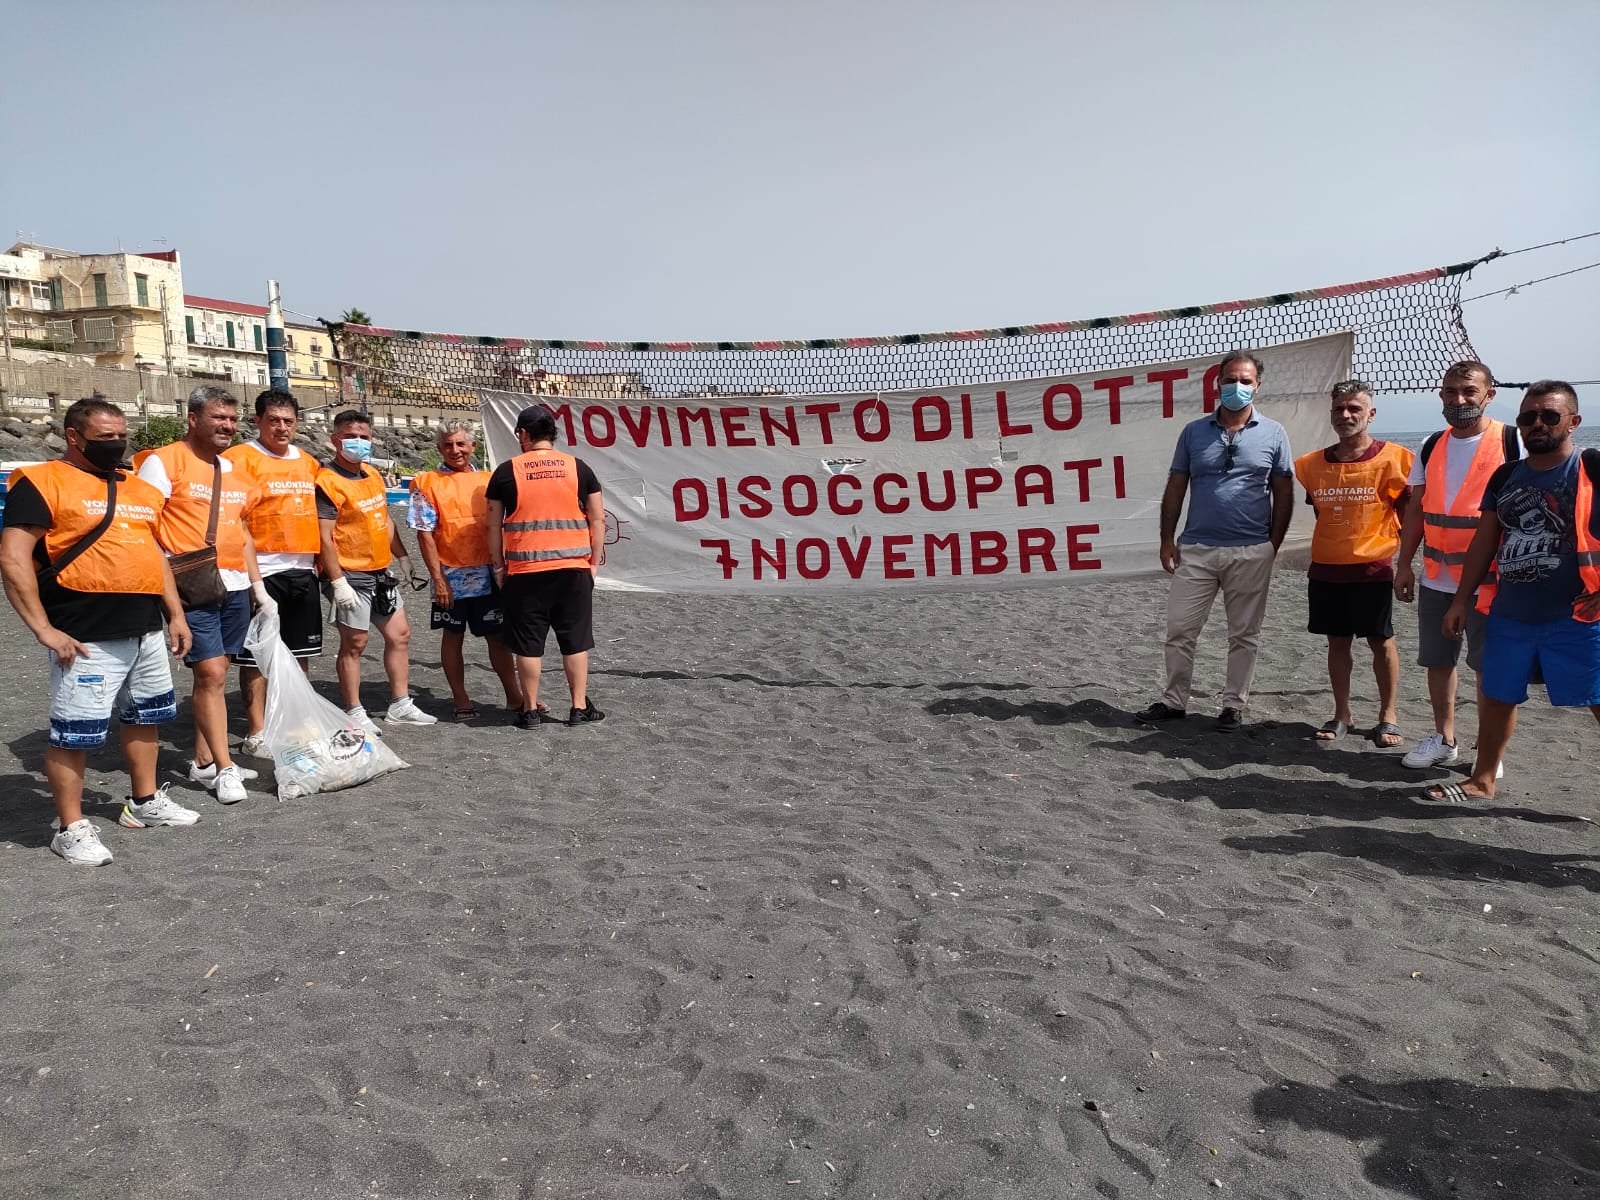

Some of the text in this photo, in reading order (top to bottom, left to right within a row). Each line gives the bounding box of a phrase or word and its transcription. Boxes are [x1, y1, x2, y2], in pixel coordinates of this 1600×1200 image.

[537, 399, 891, 448] MOVIMENTO
[911, 394, 974, 442] DI
[524, 459, 565, 469] MOVIMENTO
[672, 456, 1127, 523] DISOCCUPATI
[1313, 487, 1376, 496] VOLONTARIO
[82, 500, 154, 515] VOLNTARIO
[700, 524, 1102, 581] 7 NOVEMBRE
